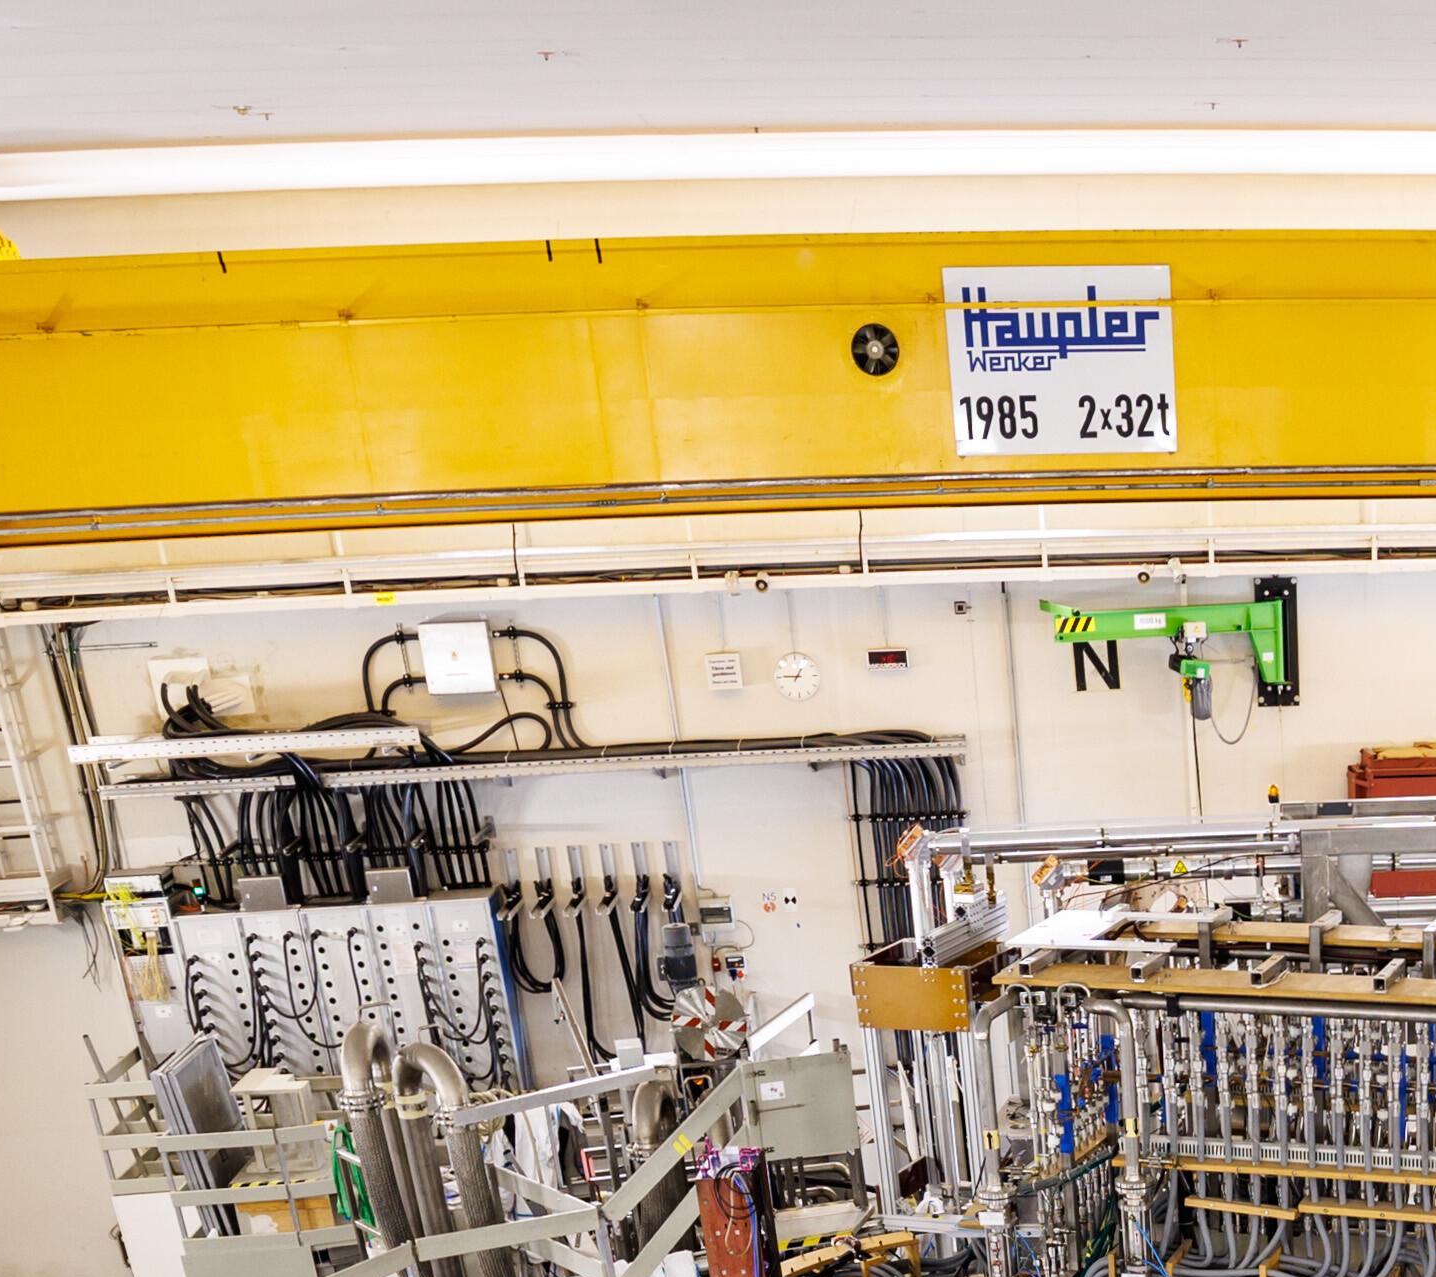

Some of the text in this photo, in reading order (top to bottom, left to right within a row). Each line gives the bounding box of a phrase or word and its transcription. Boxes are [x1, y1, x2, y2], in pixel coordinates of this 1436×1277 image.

[967, 350, 1057, 373] Wenker
[959, 395, 1039, 440] 1985
[1072, 640, 1121, 692] N
